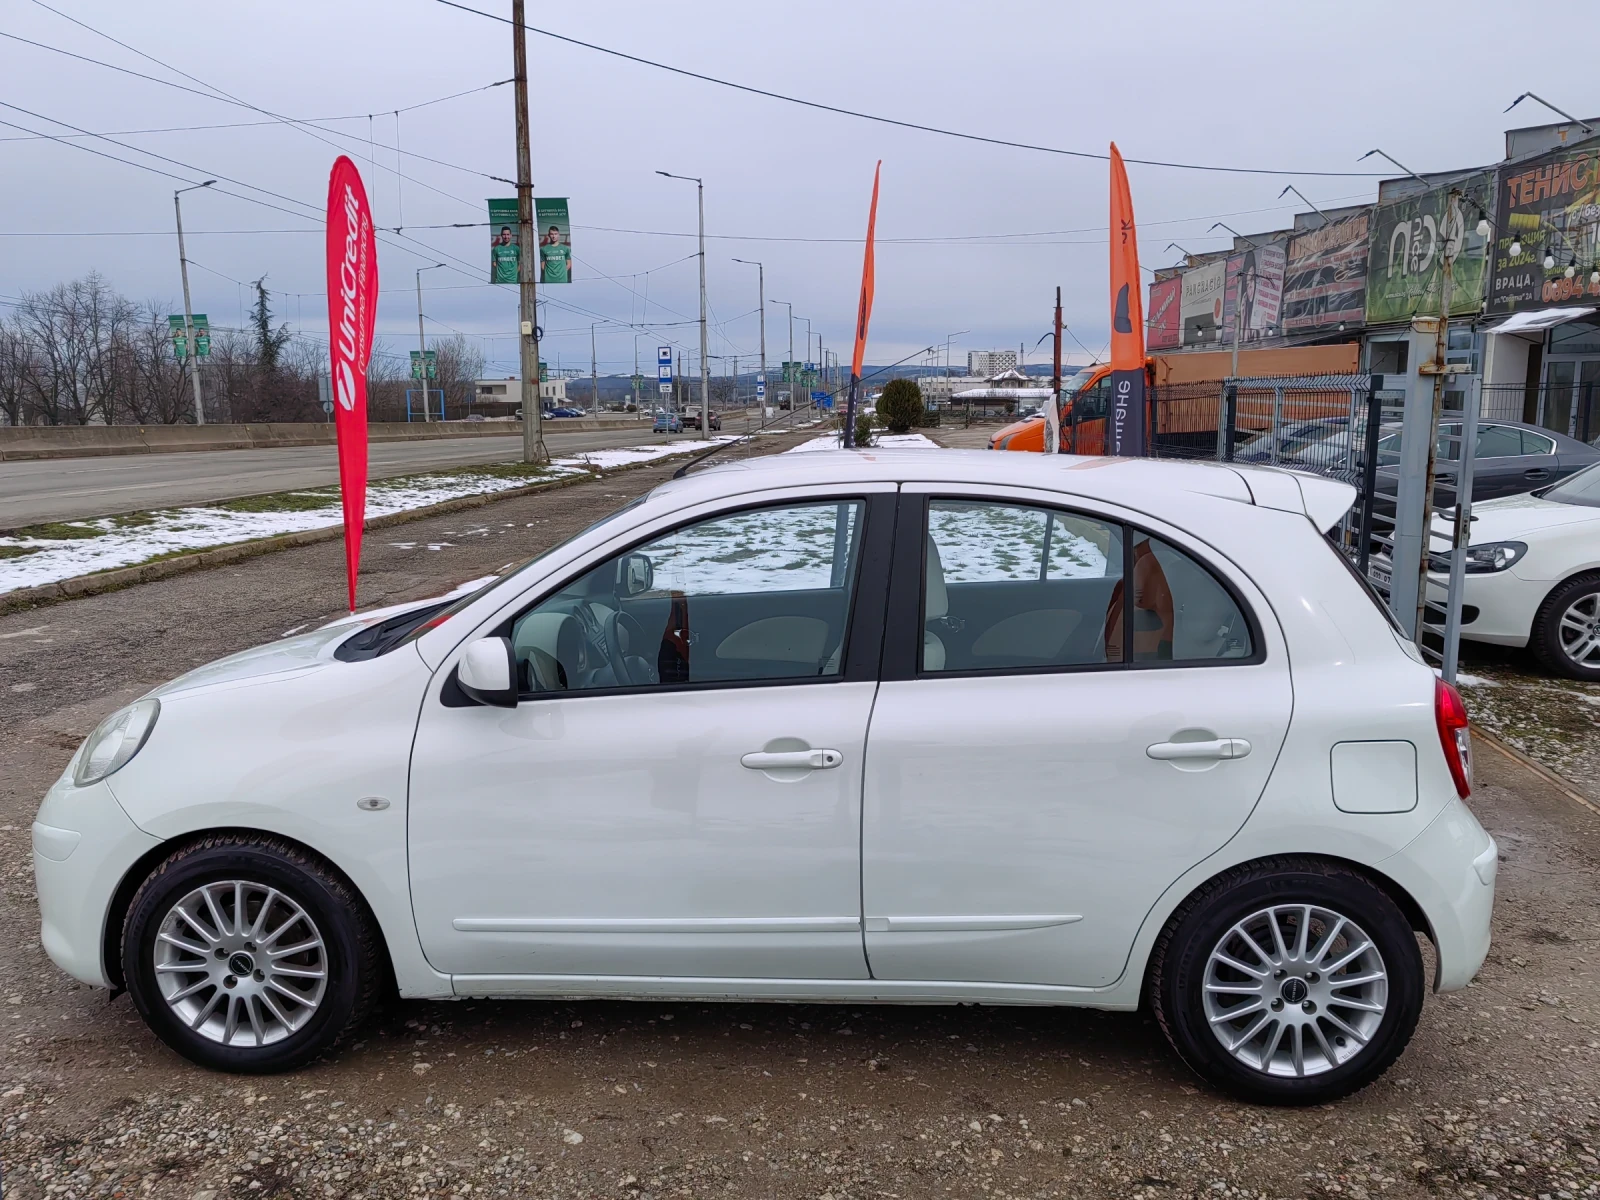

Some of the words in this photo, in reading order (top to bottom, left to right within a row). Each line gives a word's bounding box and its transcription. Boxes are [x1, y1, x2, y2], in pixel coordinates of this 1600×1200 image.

[1507, 153, 1590, 208] ТЕНИС
[338, 183, 359, 362] UniCredit
[357, 212, 369, 290] Financing
[1497, 257, 1507, 272] за
[1495, 273, 1534, 290] ВРАЦА,
[1542, 274, 1584, 302] 0894
[357, 291, 367, 376] Consumer
